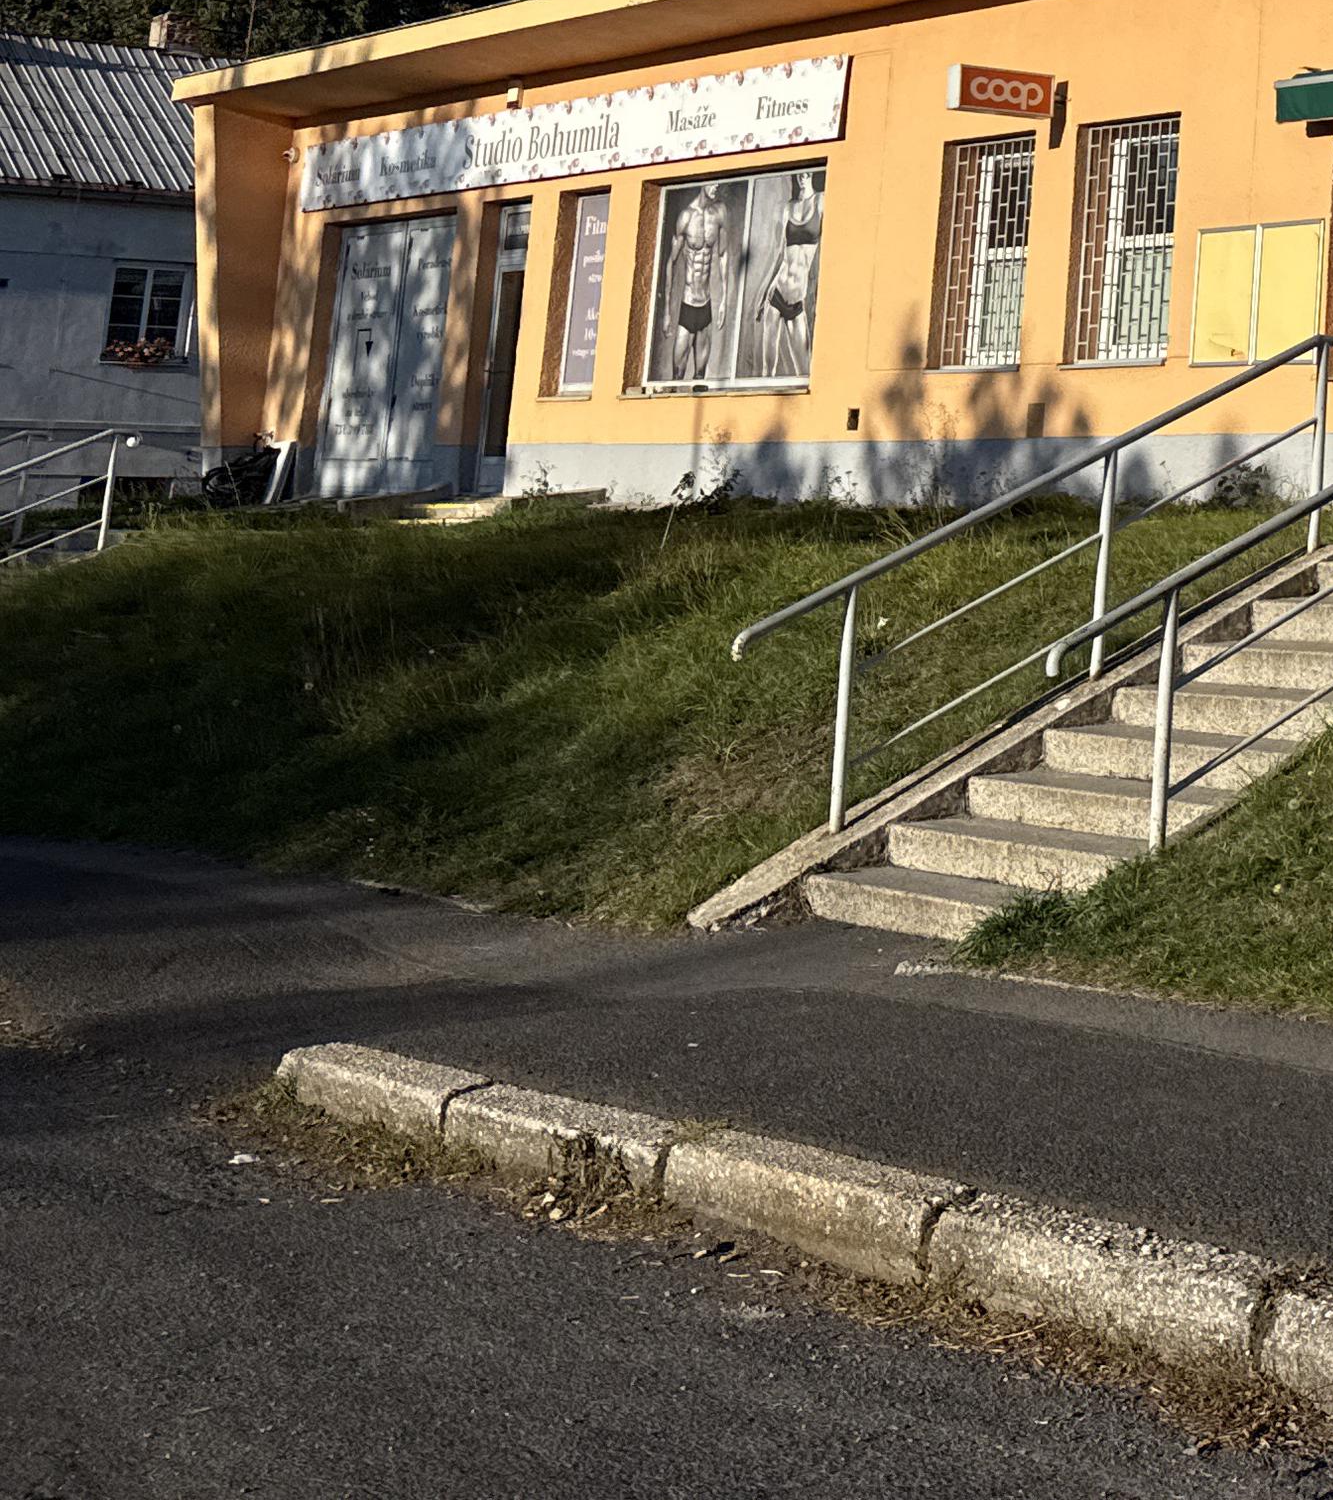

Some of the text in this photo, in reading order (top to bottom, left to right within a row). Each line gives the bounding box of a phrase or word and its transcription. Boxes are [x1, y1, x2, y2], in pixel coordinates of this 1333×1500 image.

[970, 76, 1045, 110] coop
[379, 148, 437, 177] Kosmetika
[462, 127, 524, 169] Studio
[527, 113, 620, 161] Bohumila
[666, 104, 717, 134] Masáže
[755, 94, 810, 121] Fitness
